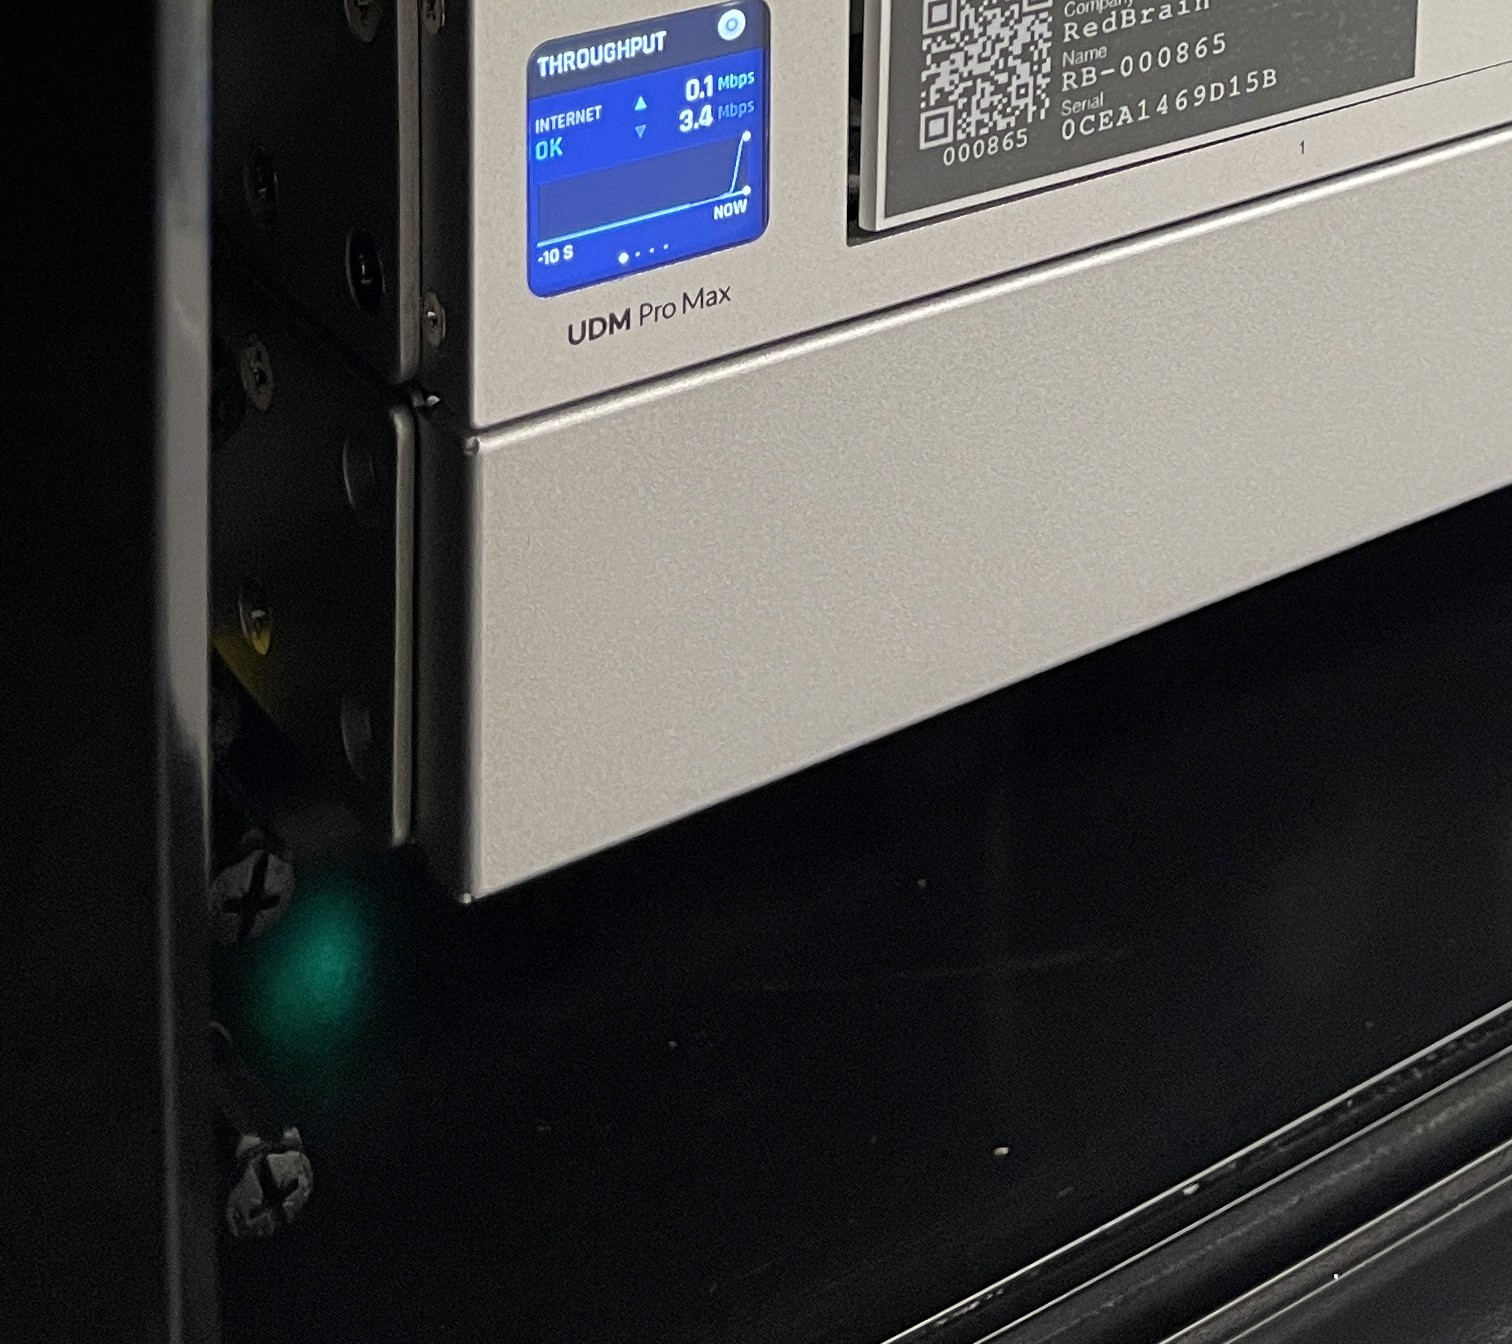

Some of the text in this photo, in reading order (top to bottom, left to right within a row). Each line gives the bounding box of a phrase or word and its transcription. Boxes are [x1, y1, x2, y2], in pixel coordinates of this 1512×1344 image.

[537, 30, 667, 78] THROUGHPUT
[1061, 45, 1108, 68] Name
[1061, 32, 1226, 92] RB-000865
[535, 70, 755, 134] INTERNET 0.1 Mbps
[535, 99, 755, 161] OK 3.4 Mbps
[1061, 91, 1104, 117] Serial
[943, 127, 1028, 166] 000865
[537, 198, 748, 266] -10 S NOW
[567, 286, 731, 346] UDM Pro Max
